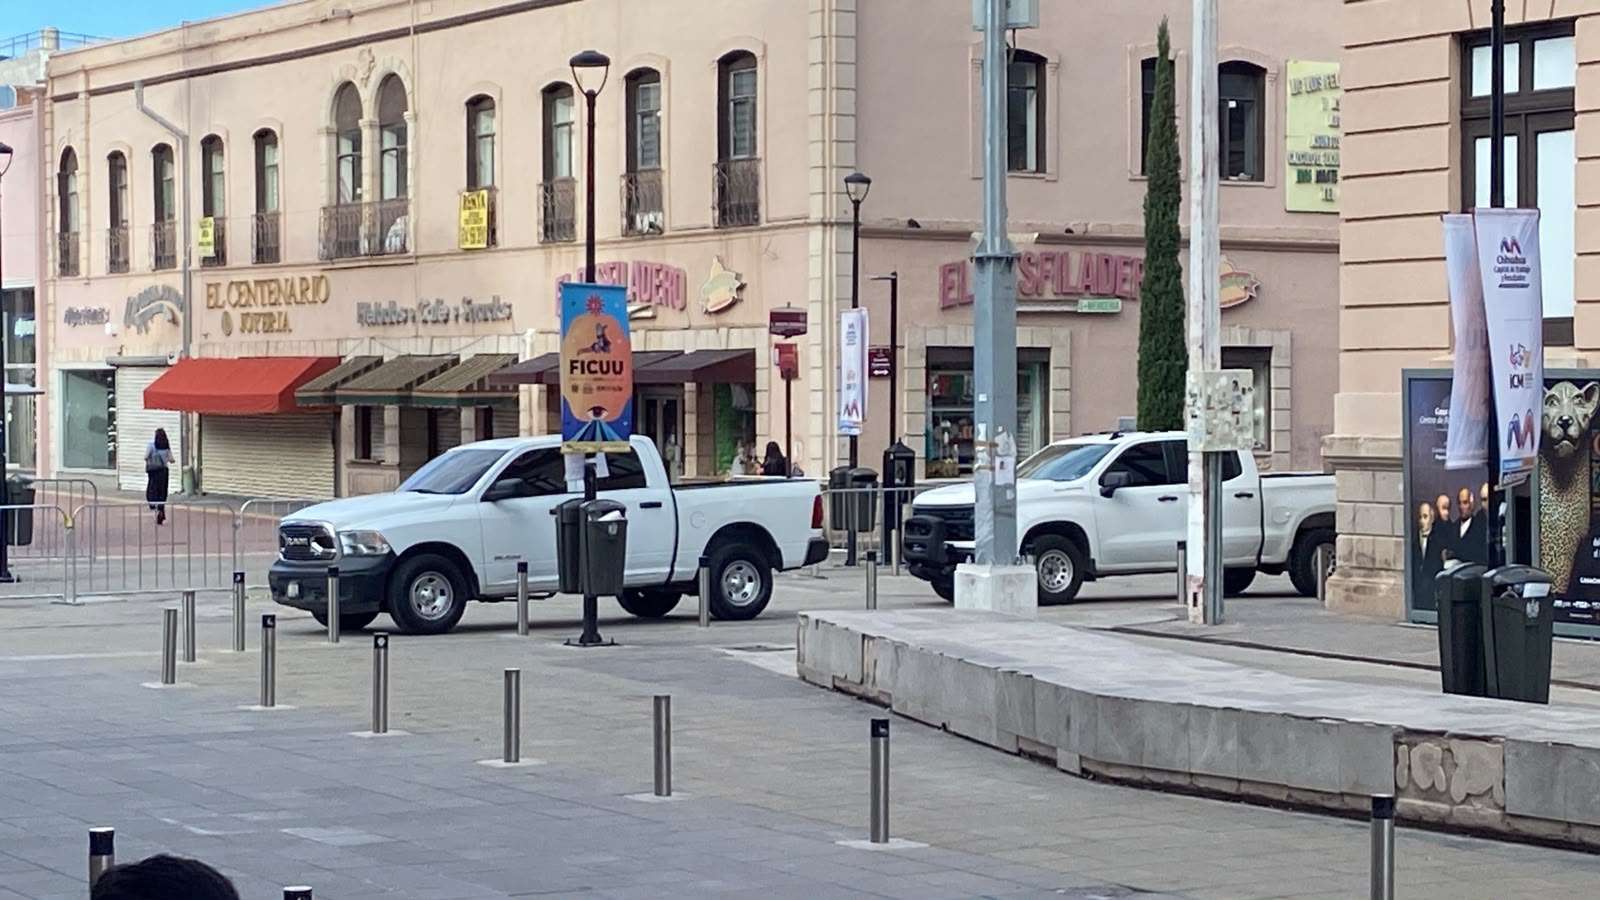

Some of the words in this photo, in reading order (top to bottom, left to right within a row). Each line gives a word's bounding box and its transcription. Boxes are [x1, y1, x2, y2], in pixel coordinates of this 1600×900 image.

[206, 282, 225, 309] EL
[227, 275, 330, 308] CENTENARIO
[939, 259, 974, 310] EL
[569, 359, 624, 375] FICUU
